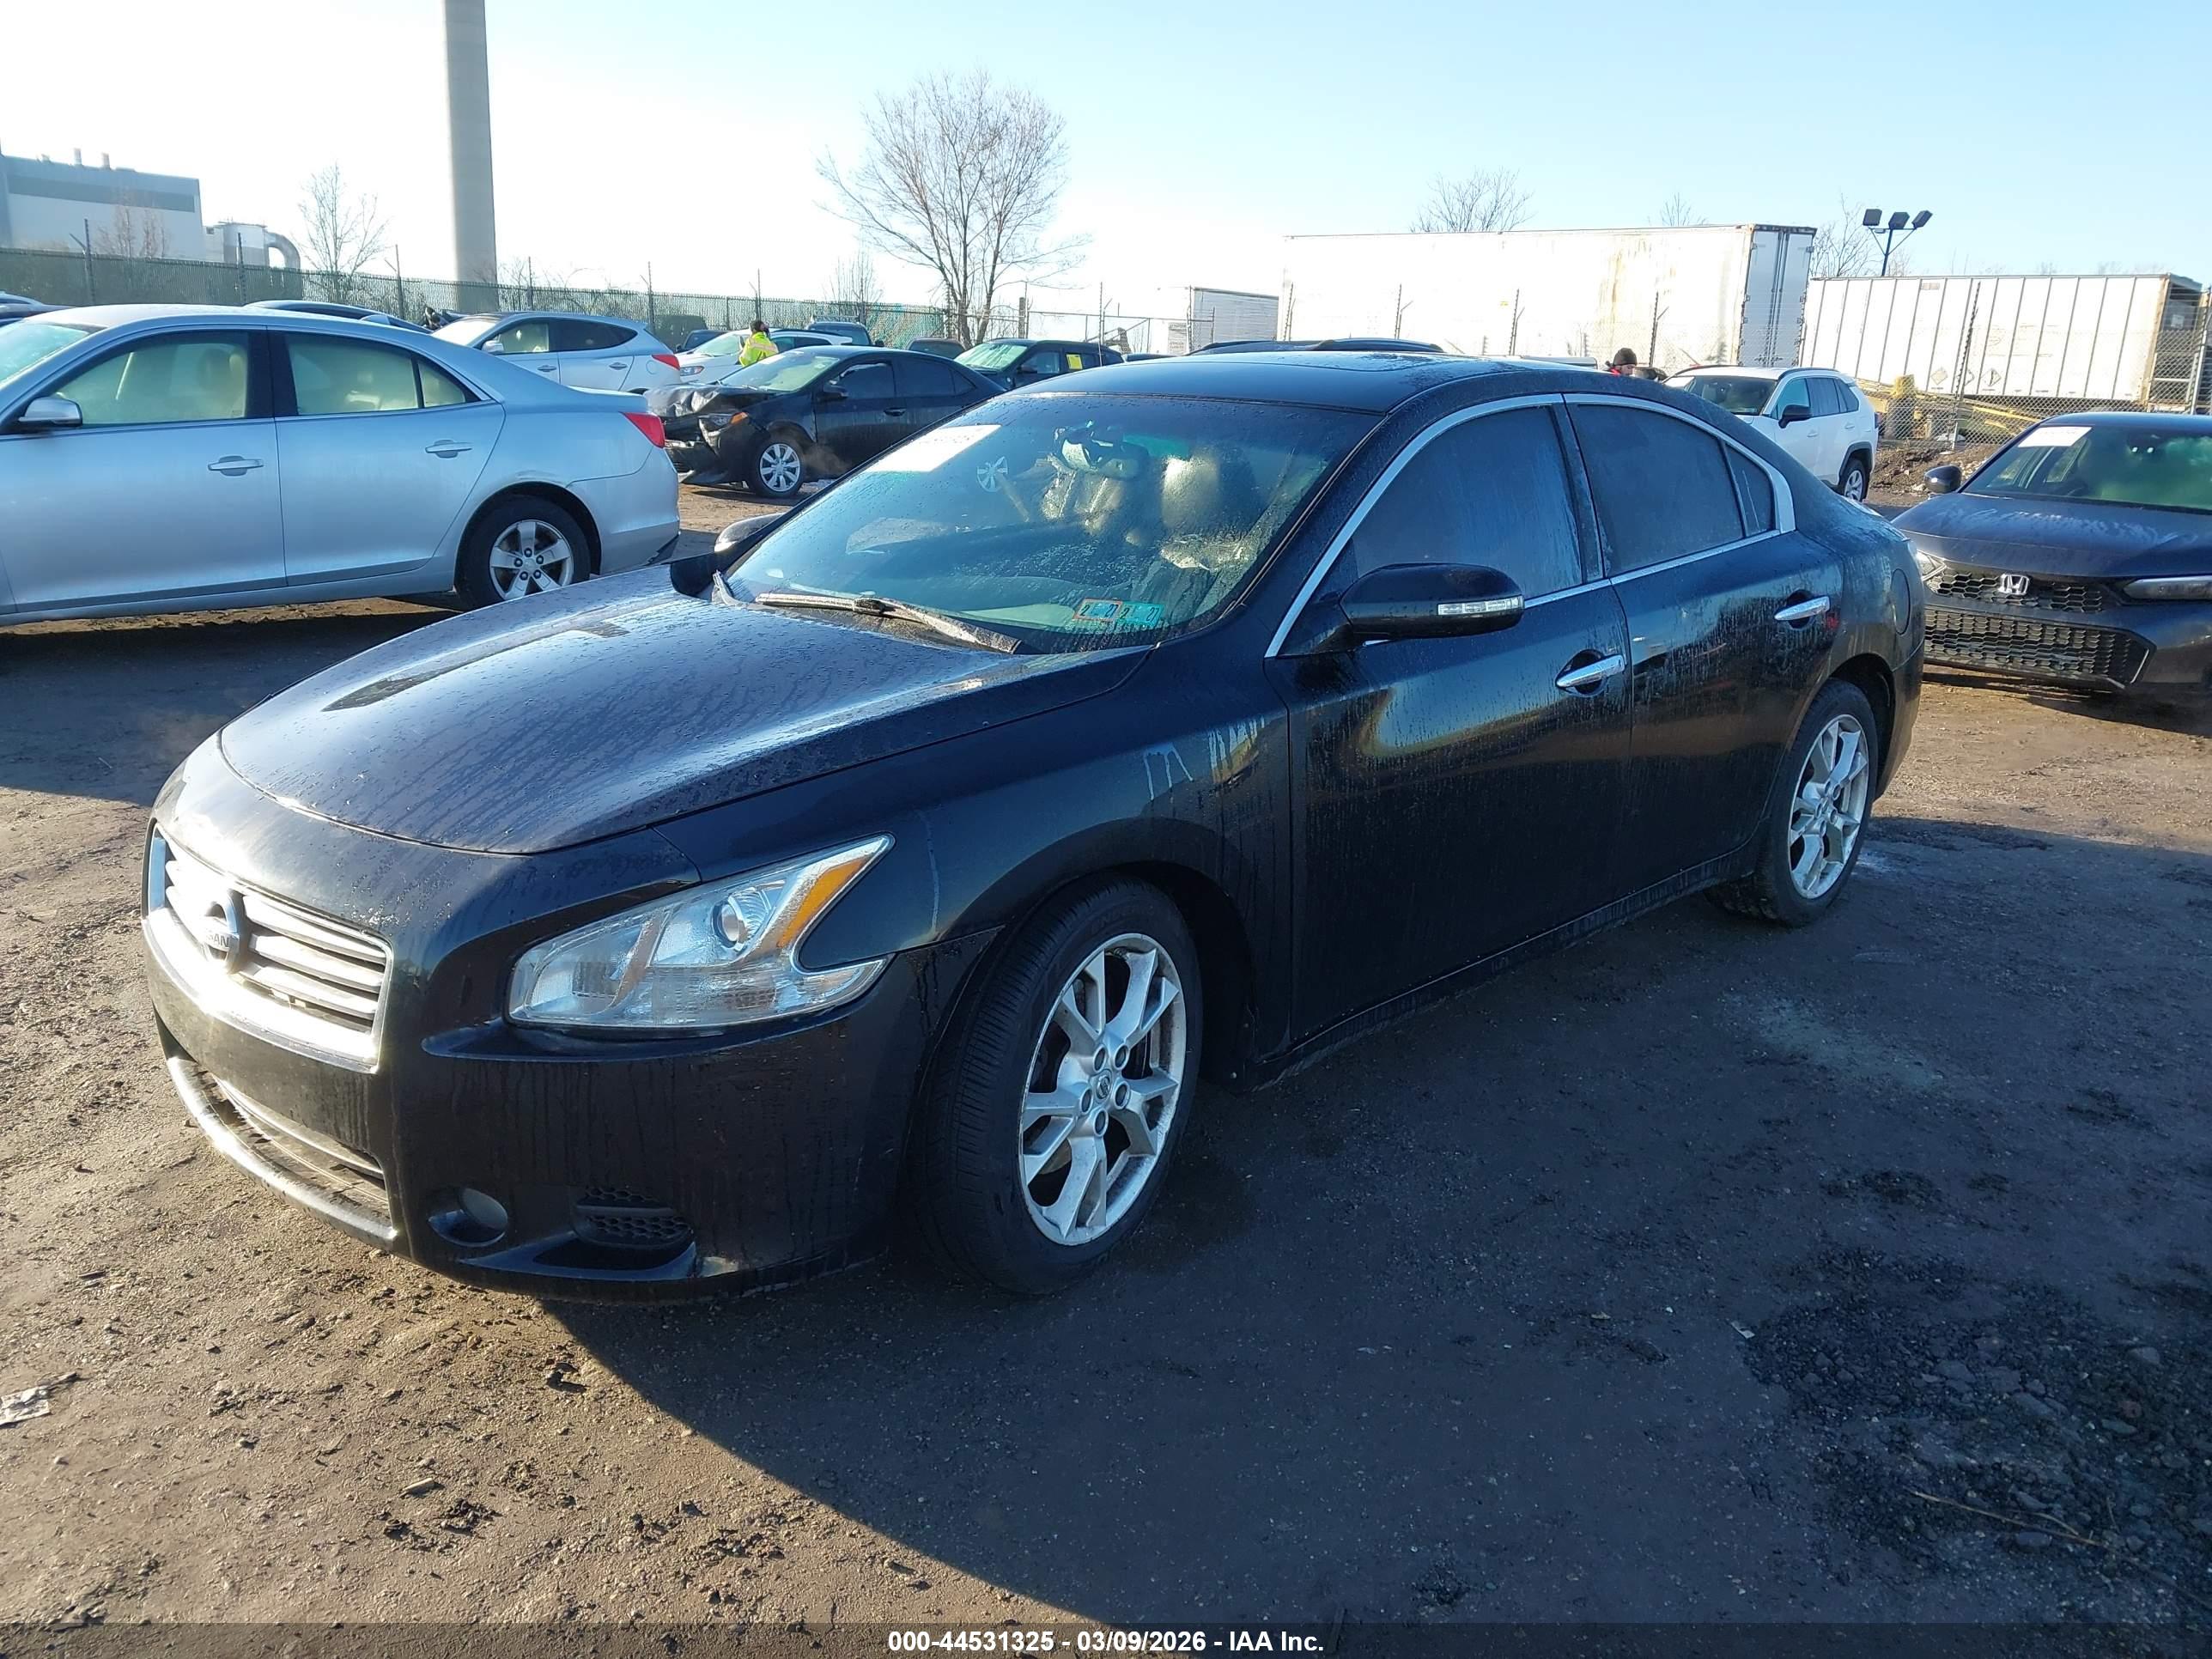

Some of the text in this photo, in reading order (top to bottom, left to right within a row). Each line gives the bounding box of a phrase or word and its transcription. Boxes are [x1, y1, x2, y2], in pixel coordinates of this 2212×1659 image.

[1079, 604, 1119, 618] 2 27
[1120, 606, 1160, 622] 2 27
